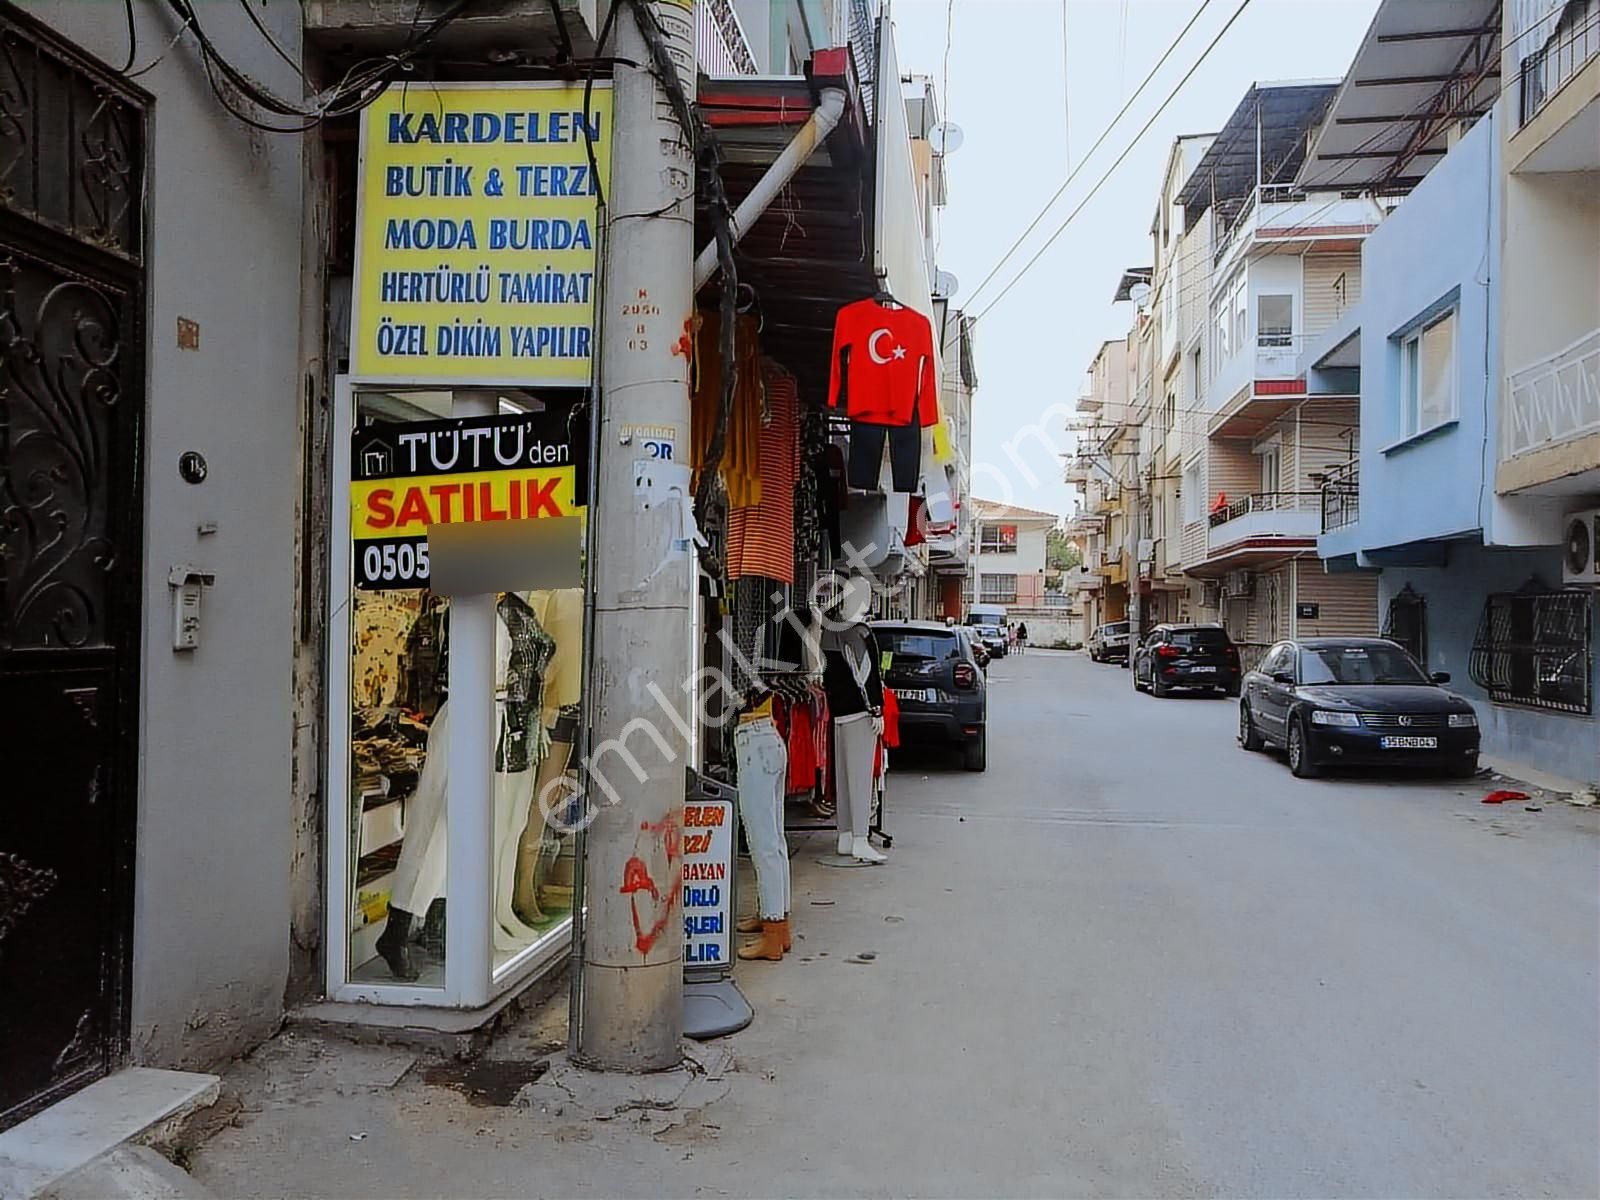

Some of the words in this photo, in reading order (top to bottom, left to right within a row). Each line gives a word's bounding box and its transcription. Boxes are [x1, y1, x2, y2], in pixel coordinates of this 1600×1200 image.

[388, 111, 601, 143] KARDELEN
[385, 158, 472, 196] BUTİK
[484, 168, 503, 196] &
[385, 219, 477, 249] MODA
[489, 219, 592, 249] BURDA
[381, 265, 490, 302] HERTÜRLÜ
[499, 265, 592, 303] TAMİRAT
[377, 317, 428, 356] ÖZEL
[437, 318, 501, 356] DİKİM
[510, 325, 591, 357] YAPILIR
[366, 477, 563, 530] SATILIK
[364, 544, 429, 581] 0505
[683, 863, 725, 880] BAYAN
[683, 911, 724, 939] ŞLERİ
[682, 943, 721, 961] LIR
